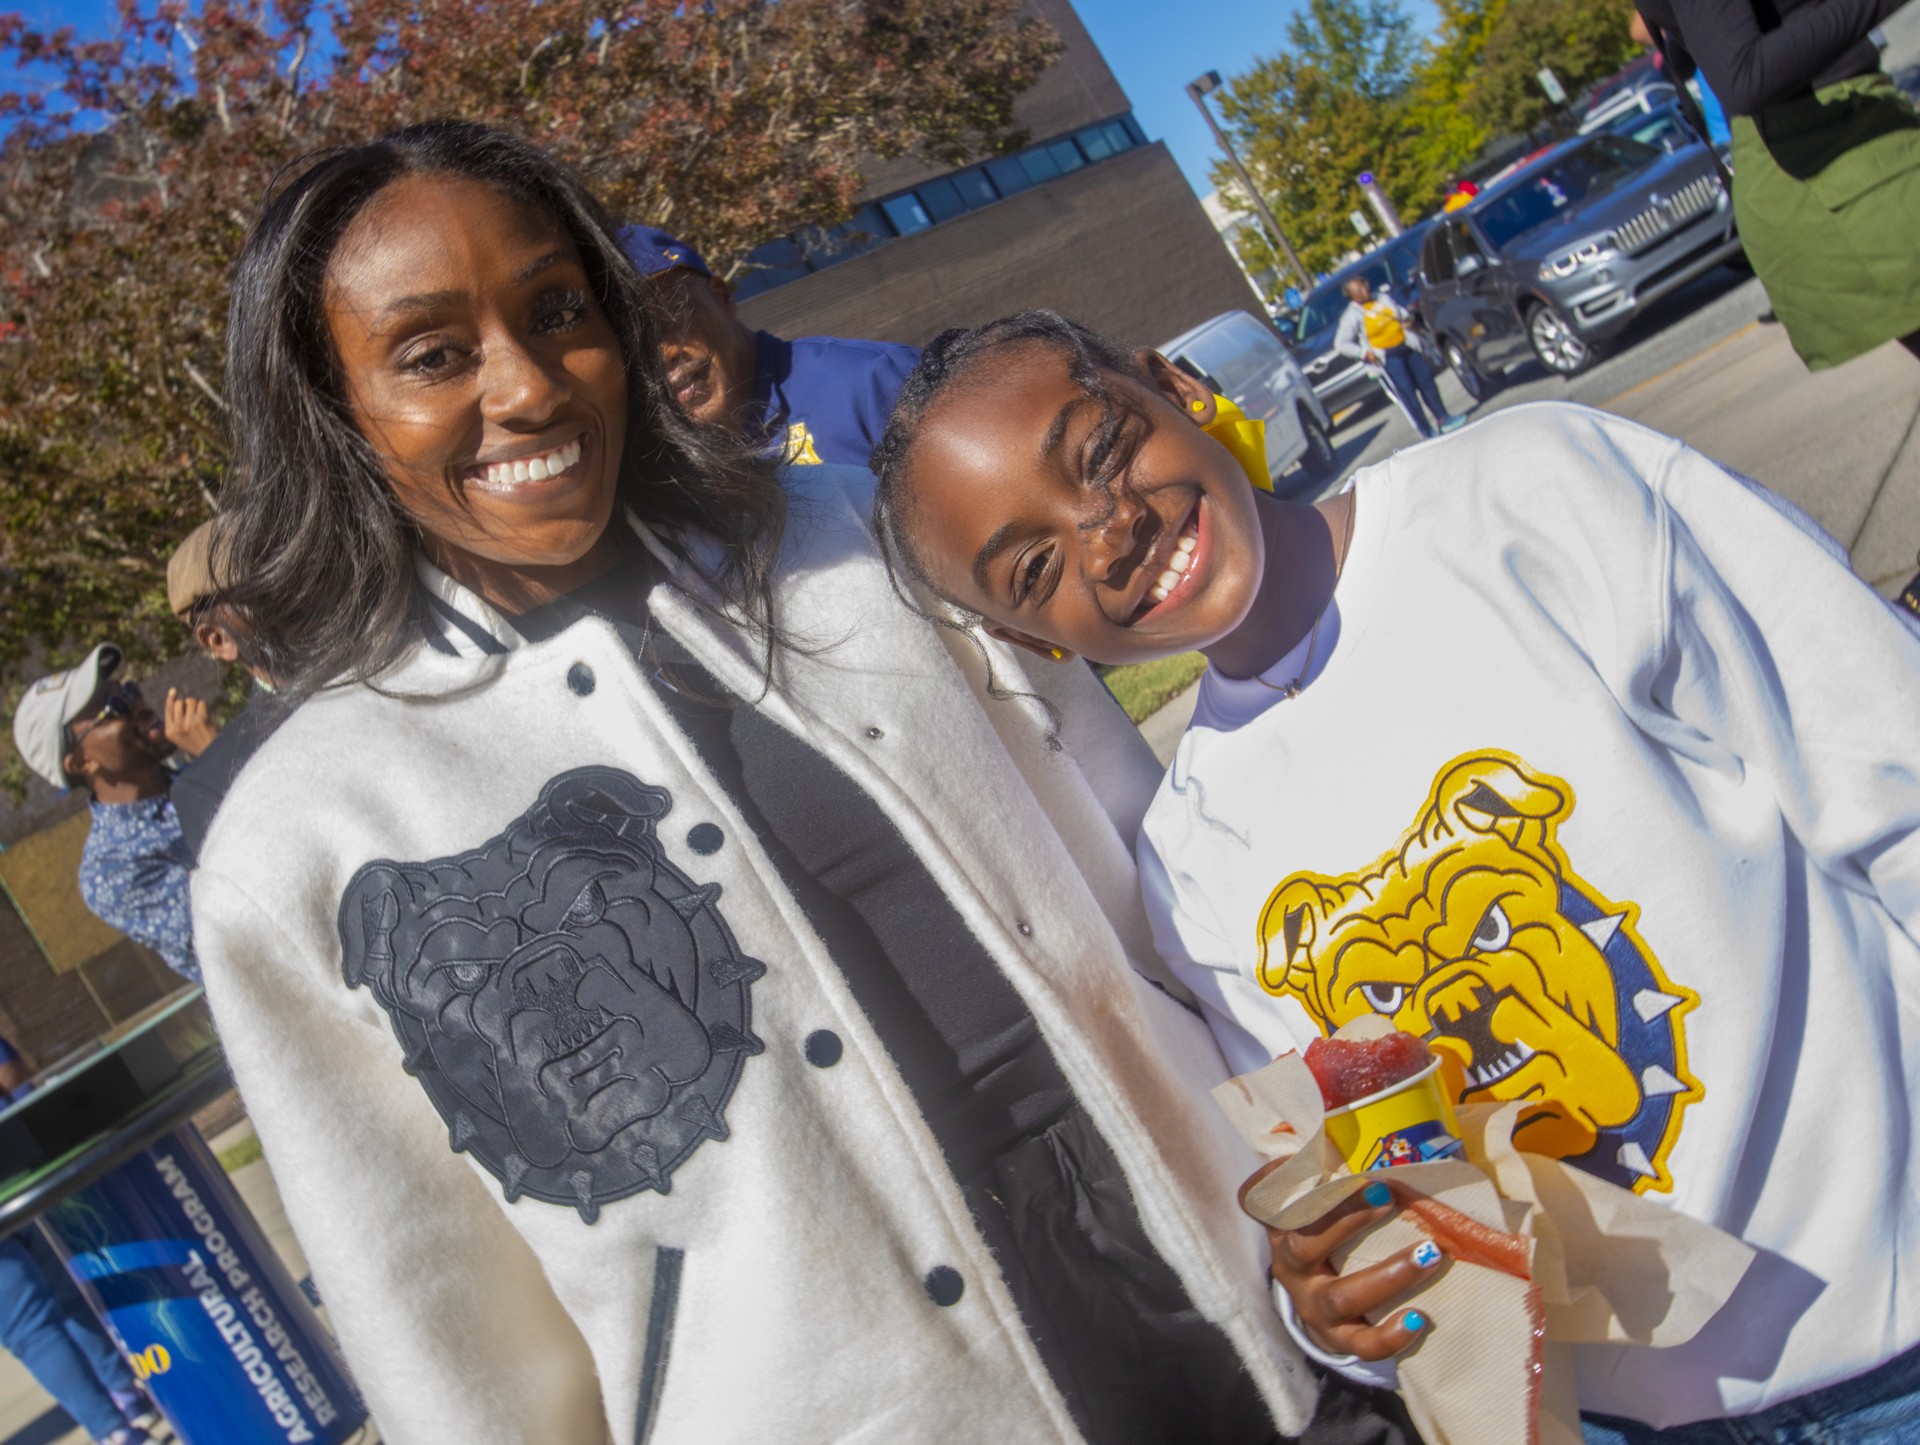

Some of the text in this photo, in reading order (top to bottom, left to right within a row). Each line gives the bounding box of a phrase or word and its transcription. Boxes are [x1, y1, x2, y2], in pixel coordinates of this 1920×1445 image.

[156, 1154, 337, 1428] RESEARCH PROGRAM
[181, 1249, 314, 1444] AGRICULTURAL
